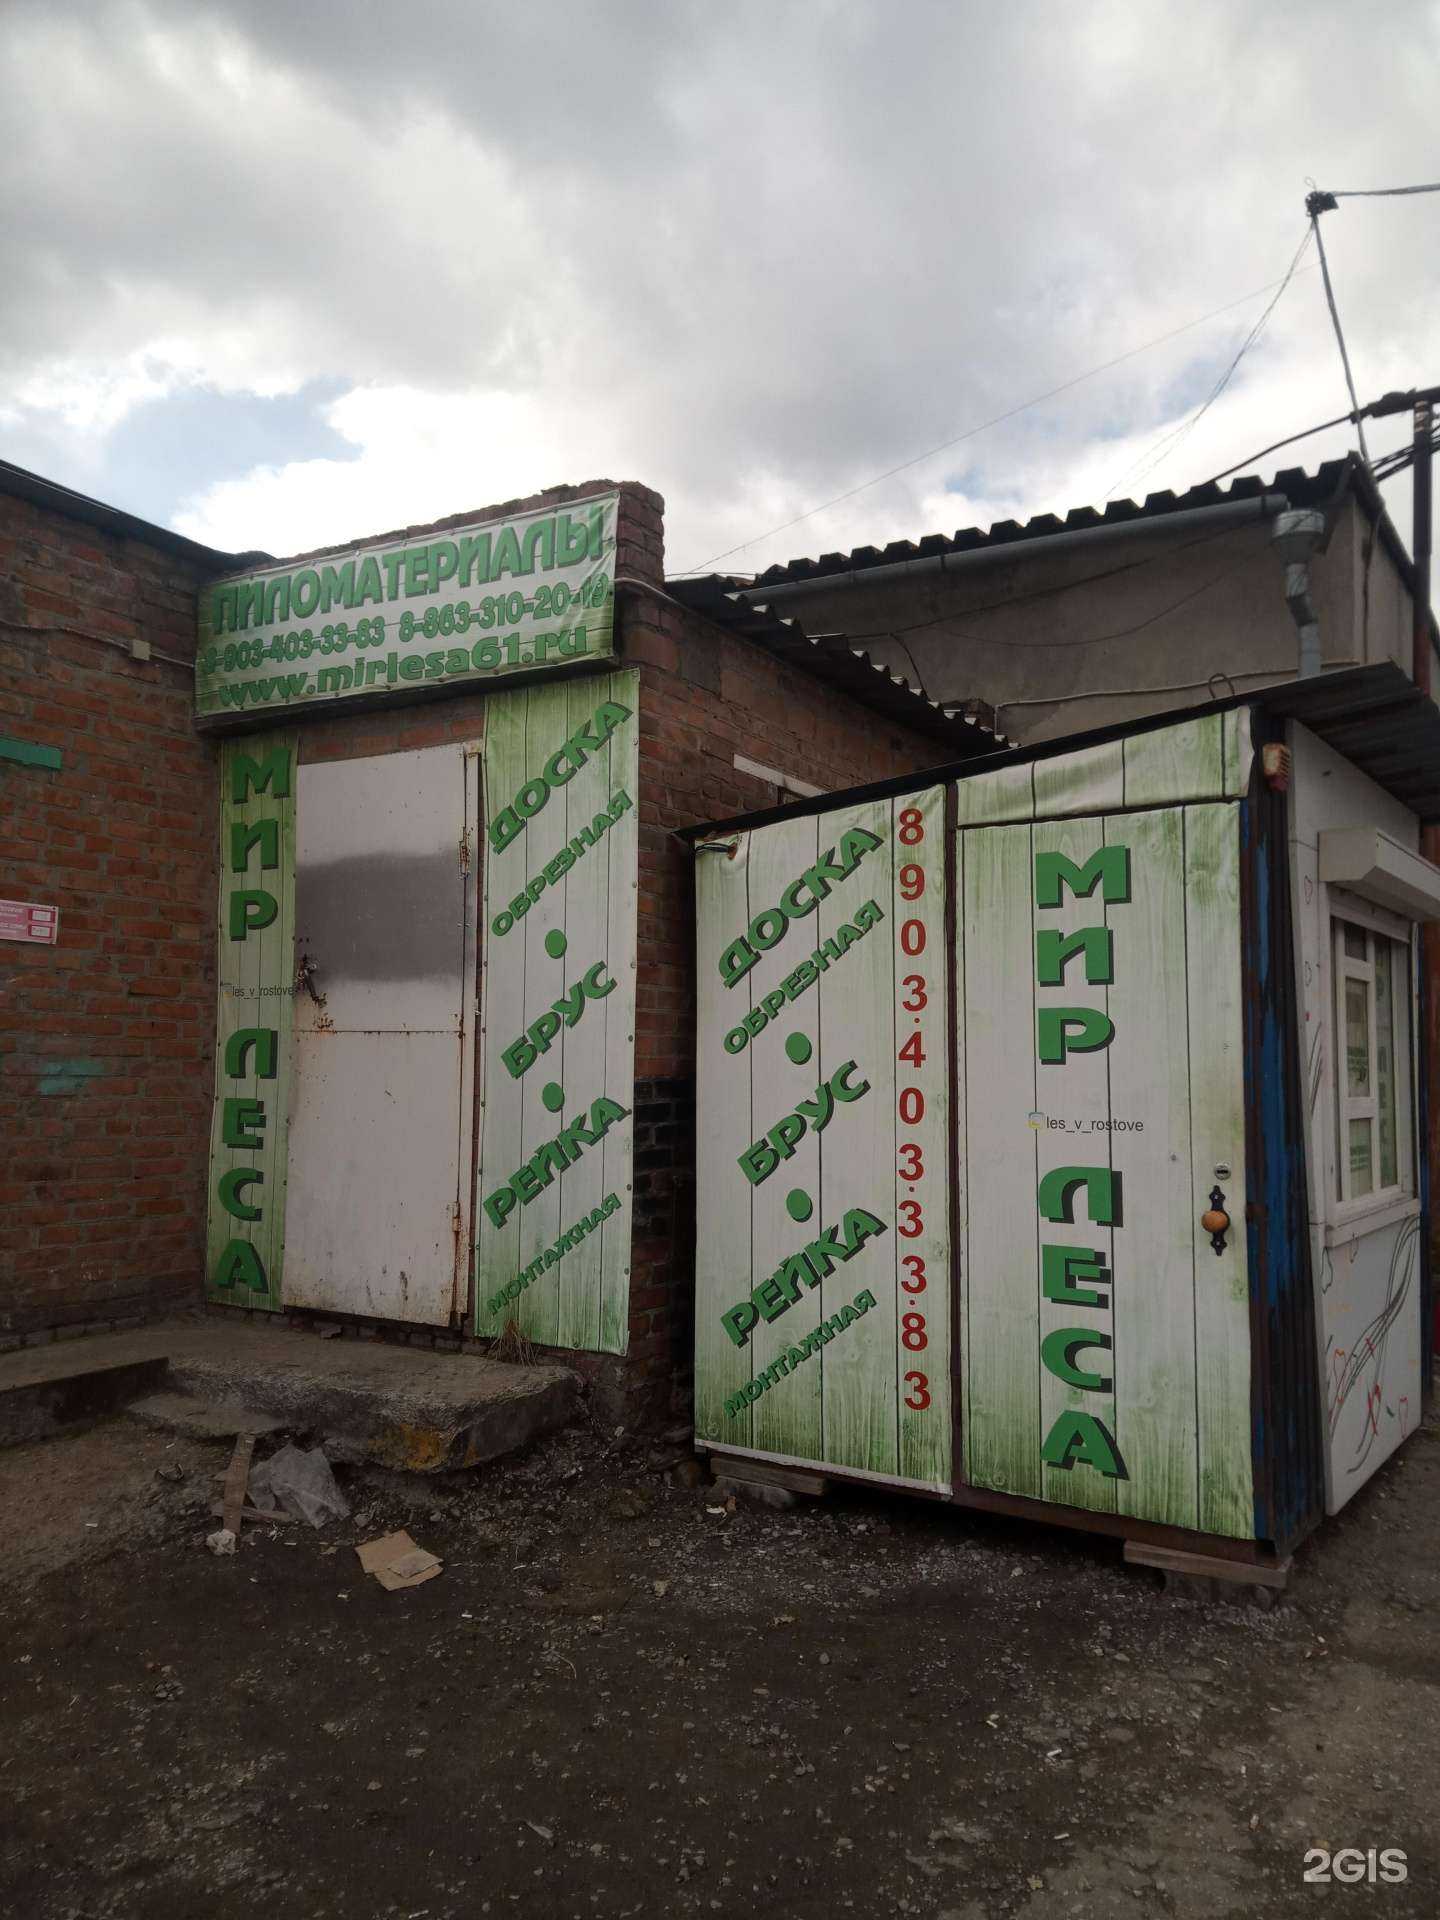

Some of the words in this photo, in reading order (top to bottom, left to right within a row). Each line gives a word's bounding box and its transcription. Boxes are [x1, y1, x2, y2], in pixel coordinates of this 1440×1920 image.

[212, 505, 604, 635] ПИЛОМАТЕРИАЛЫ
[219, 626, 588, 706] www.mirlesa61.ru
[488, 701, 634, 855] ДОСКА
[491, 789, 634, 936] ОБРЕЗНАЯ
[719, 828, 884, 989] ДОСКА
[501, 961, 618, 1079] БРУС
[724, 900, 885, 1054] ОБРЕЗНАЯ
[217, 1028, 278, 1294] ЛЕСА
[483, 1097, 628, 1229] РЕЙКА
[737, 1060, 871, 1186] БРУС
[1046, 1115, 1145, 1134] les_v_rostove
[487, 1192, 622, 1316] МОНТАЖНАЯ
[720, 1208, 888, 1348] РЕЙКА
[724, 1289, 877, 1418] МОНТАЖНАЯ
[1038, 1166, 1130, 1480] ЛЕСА
